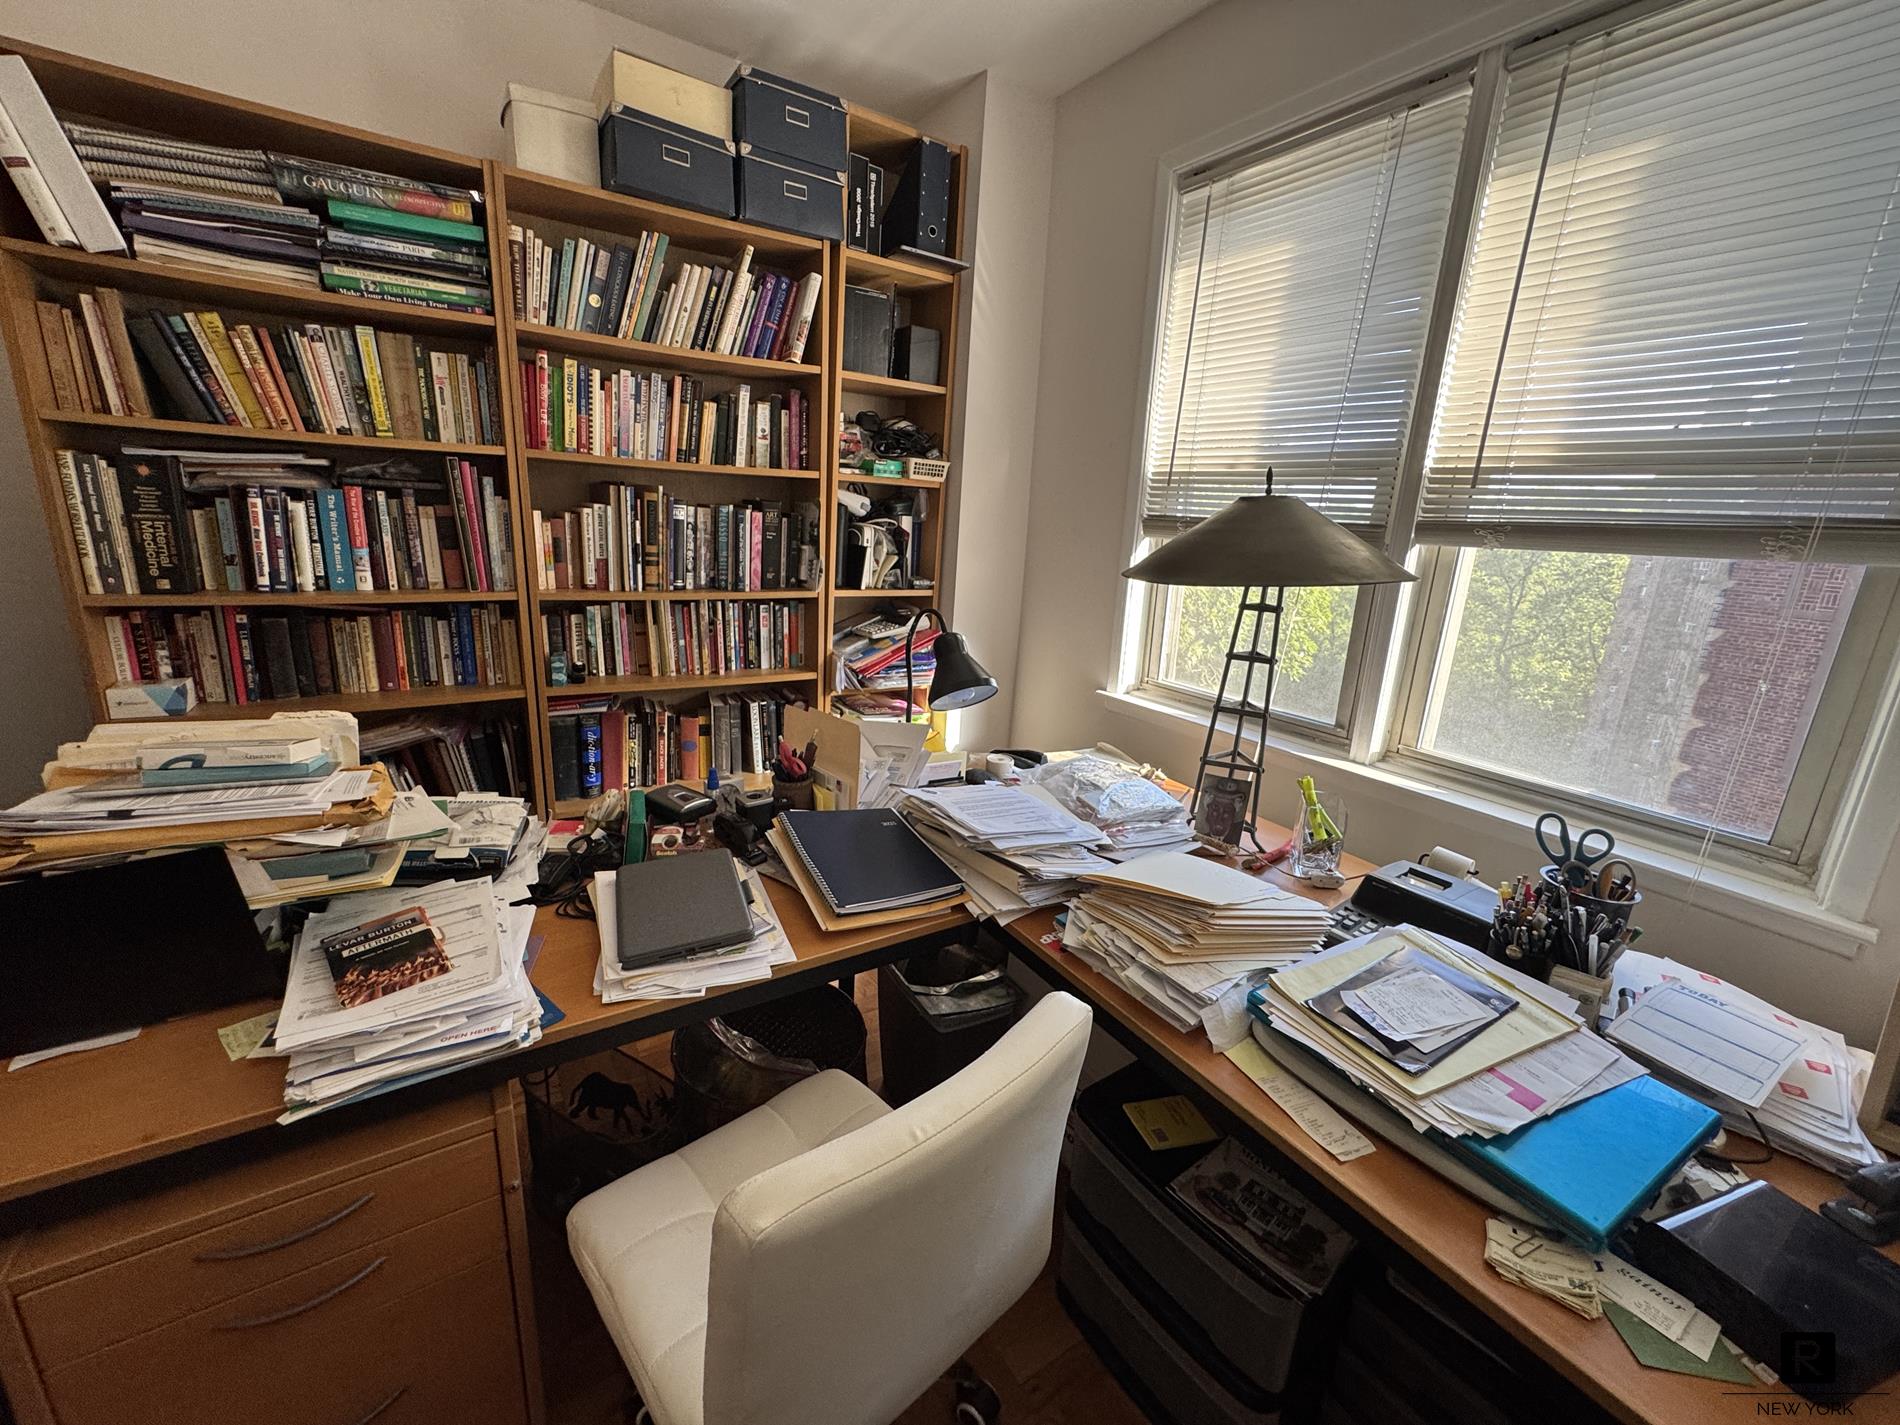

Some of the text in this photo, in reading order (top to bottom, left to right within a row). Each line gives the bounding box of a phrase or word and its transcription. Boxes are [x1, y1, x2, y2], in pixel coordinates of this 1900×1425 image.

[303, 174, 384, 200] GAUGUIN
[402, 245, 426, 254] PARIS
[339, 288, 448, 309] Make Your Own Living Trust
[384, 284, 427, 297] VEGETARIAN
[337, 369, 350, 397] WEALTHY
[306, 499, 316, 517] LEVAR
[308, 517, 319, 540] BURTON
[327, 494, 344, 572] The Writer's Manual
[718, 507, 727, 542] PICASSO
[140, 520, 159, 577] Medicine
[153, 520, 173, 568] Internal
[134, 628, 152, 676] SPARTA
[329, 936, 364, 951] LEVAR
[368, 920, 412, 938] BURTON
[348, 929, 413, 954] AFTERMATH
[441, 1026, 496, 1042] OPEN HERE
